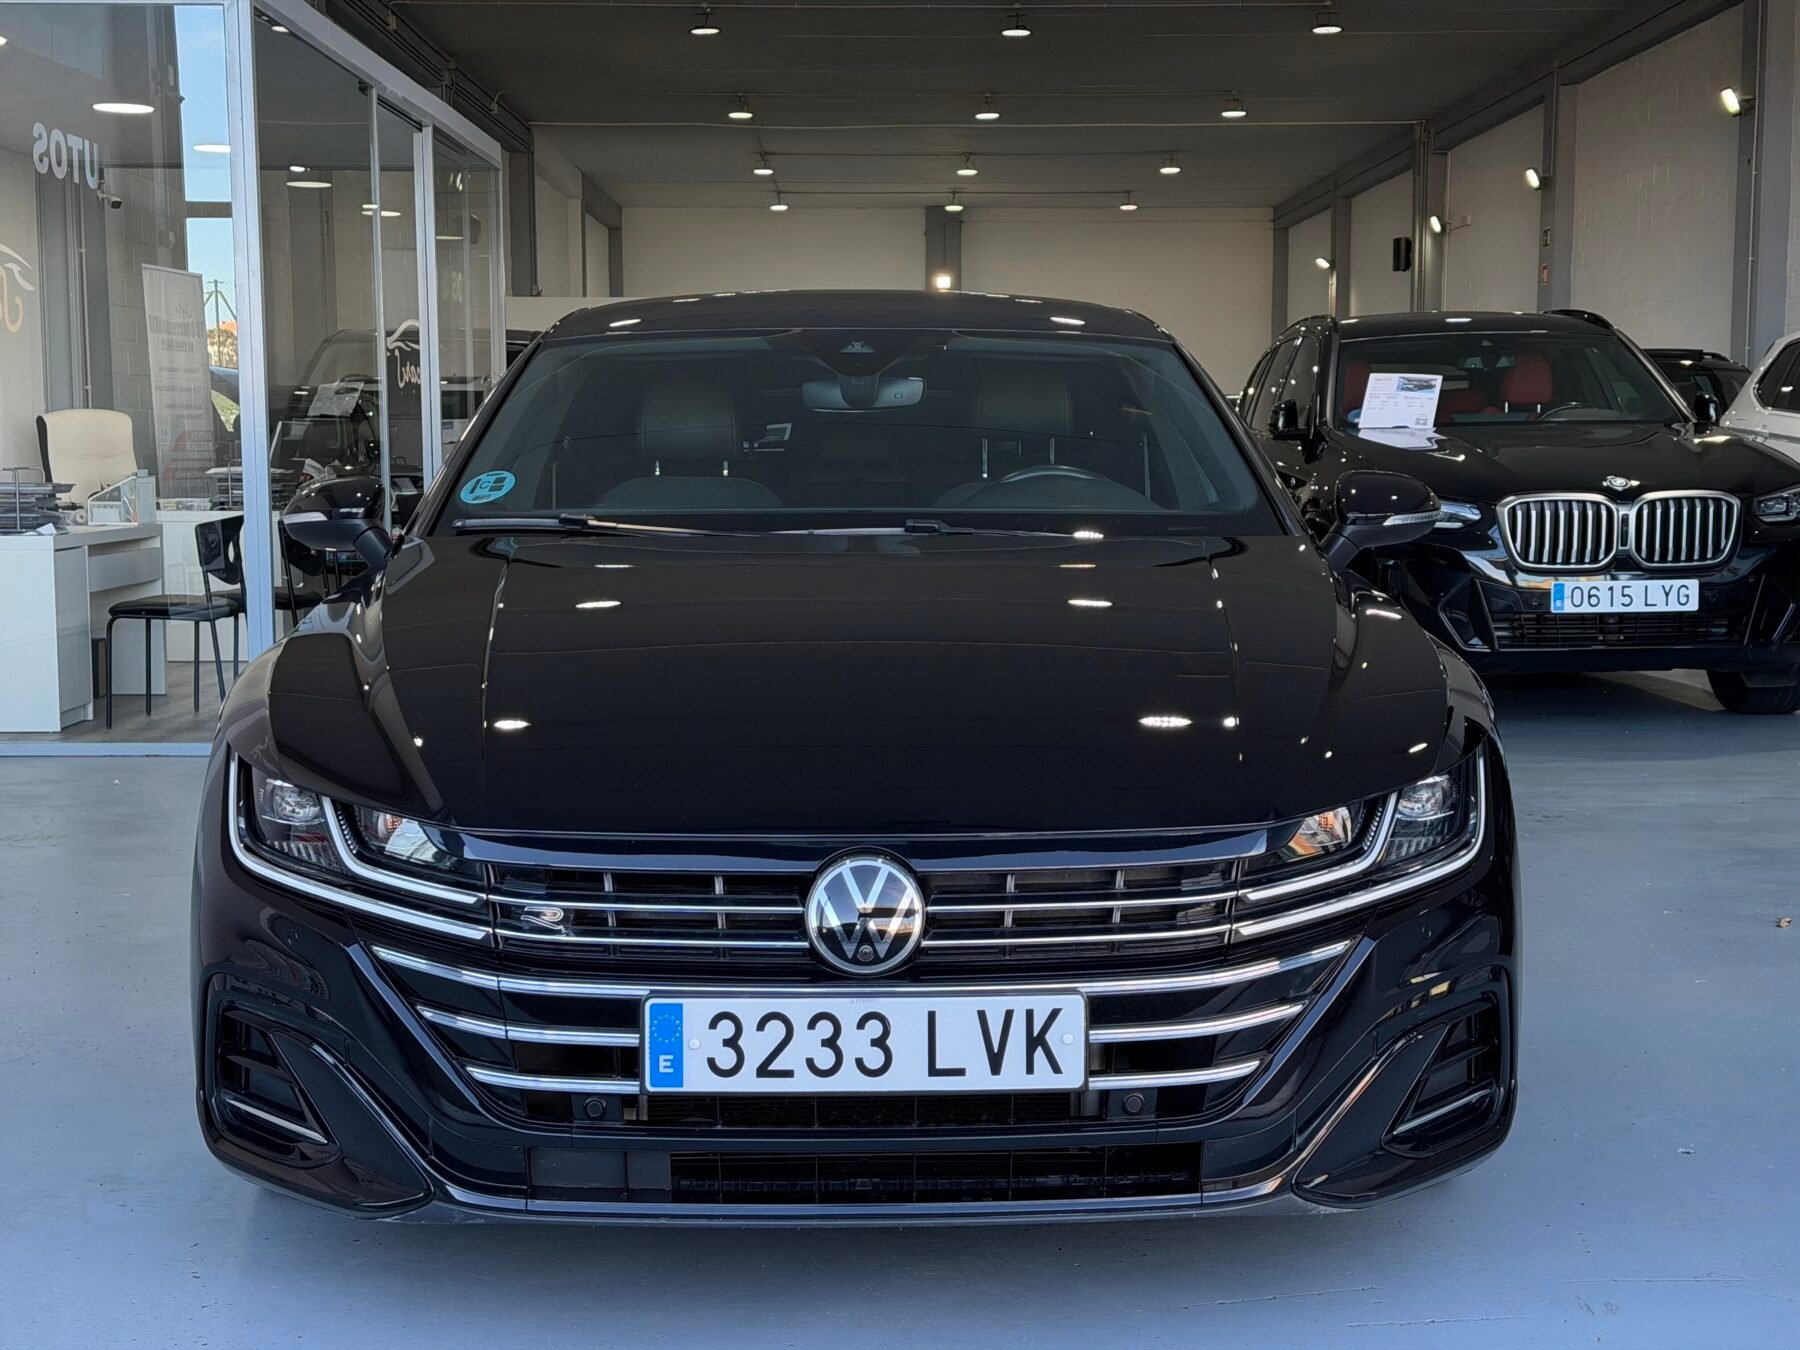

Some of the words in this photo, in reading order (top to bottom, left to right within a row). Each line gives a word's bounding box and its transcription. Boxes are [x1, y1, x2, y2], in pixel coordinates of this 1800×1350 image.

[1570, 585, 1634, 608] 0615
[1644, 584, 1690, 607] LYG
[658, 1054, 675, 1073] E
[706, 1011, 893, 1078] 3233
[927, 1007, 1064, 1077] LVK
